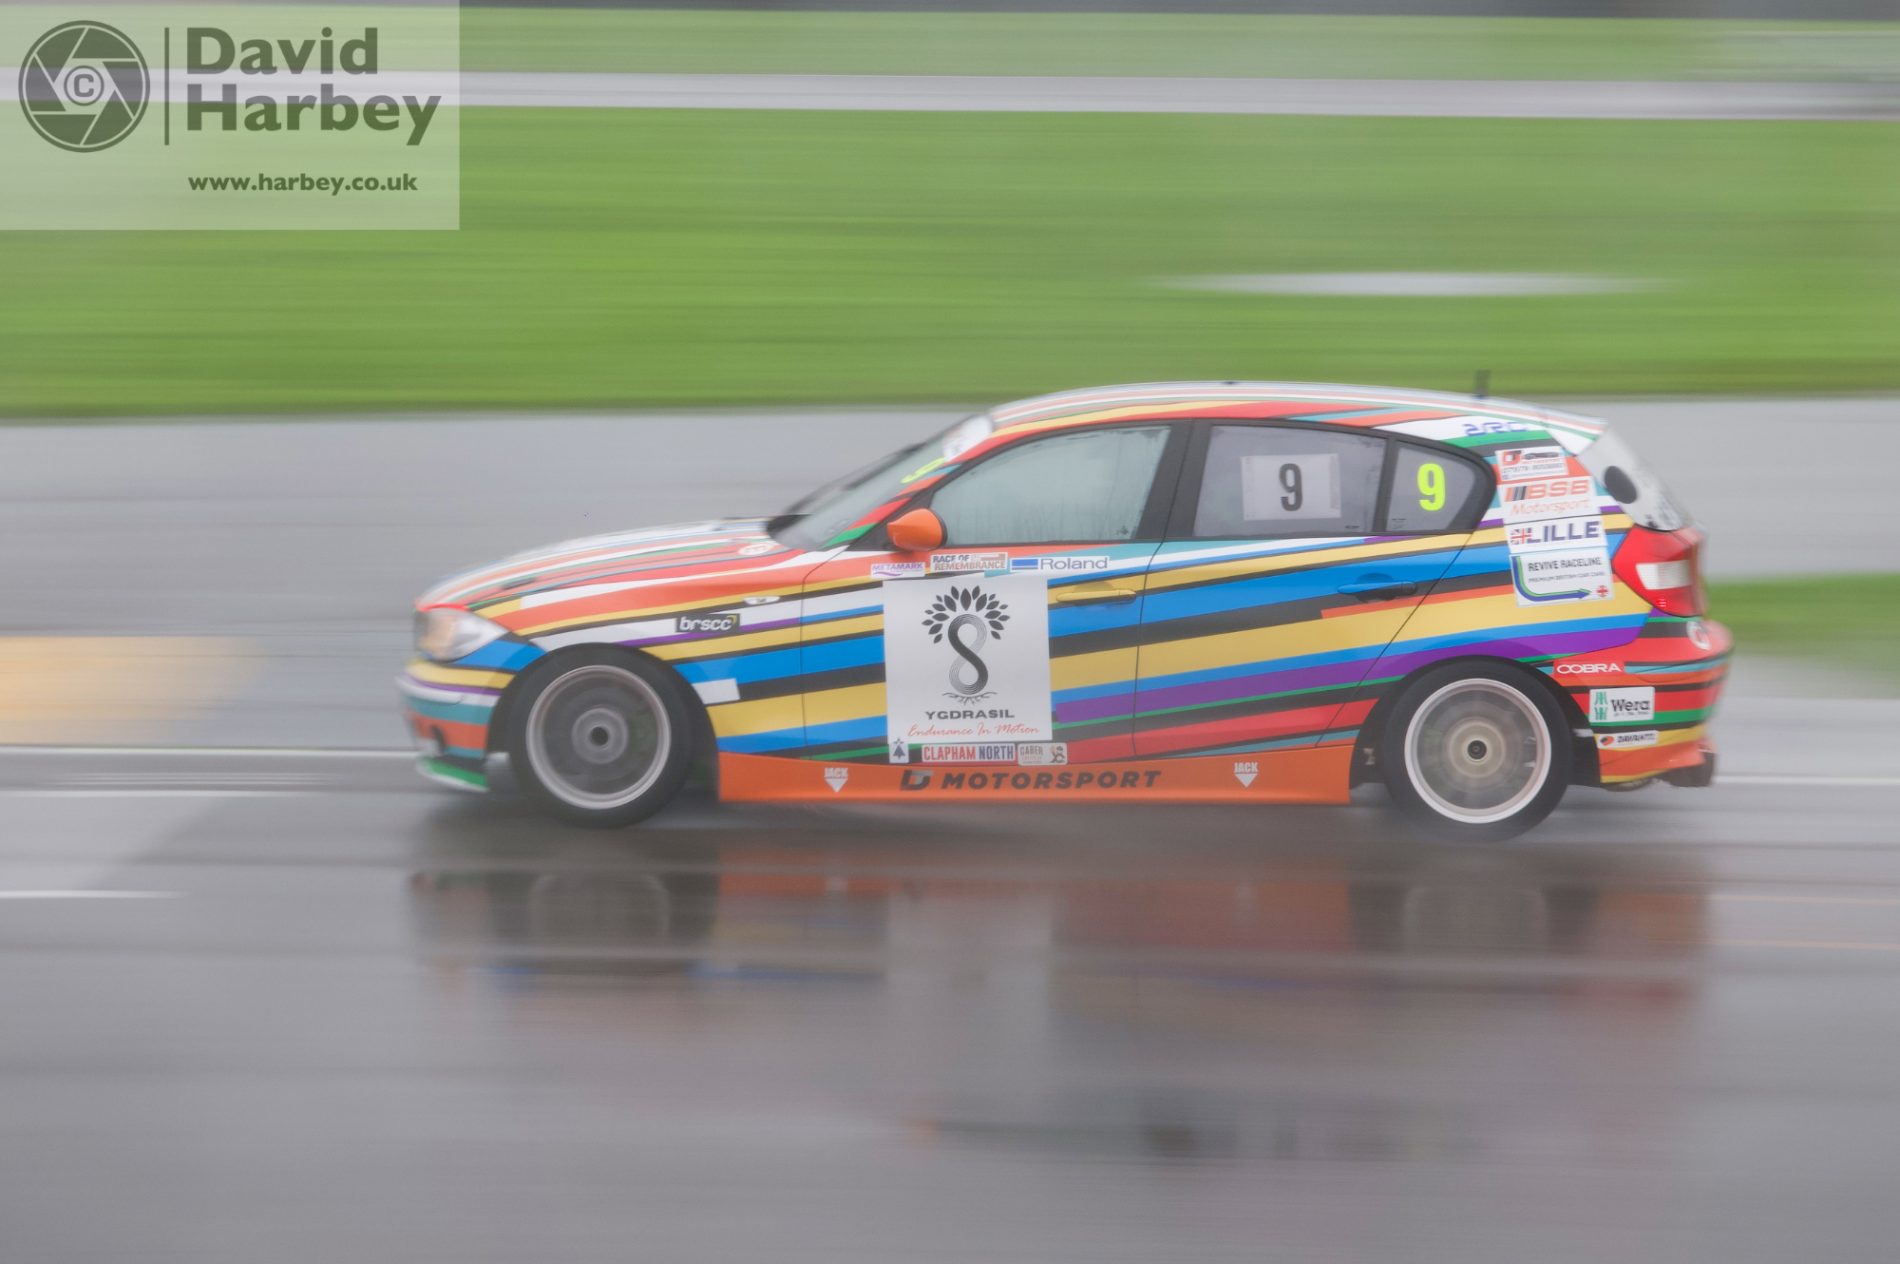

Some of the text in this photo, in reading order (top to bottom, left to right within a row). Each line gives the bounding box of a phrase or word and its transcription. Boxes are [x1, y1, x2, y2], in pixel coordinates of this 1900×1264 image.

[1278, 463, 1303, 512] 9
[1417, 463, 1446, 511] 9
[1526, 479, 1590, 500] BSB
[1525, 521, 1600, 544] LILLE
[933, 554, 970, 563] RACE OF
[1040, 557, 1109, 571] Roland
[872, 563, 923, 571] METAMARK
[934, 560, 1006, 571] REMEMBRANCE
[1528, 560, 1559, 572] REVIVE
[679, 616, 732, 631] brscc
[1556, 663, 1622, 675] COBRA
[1611, 699, 1650, 712] Wera
[925, 709, 1015, 720] YGDRASIL
[907, 722, 1041, 737] Endurance In Motion
[923, 746, 977, 760] CLAPHAM
[978, 745, 1014, 760] NORTH
[824, 768, 848, 778] JACK
[1234, 762, 1259, 773] JACK
[941, 770, 1161, 790] MOTORSPORT
